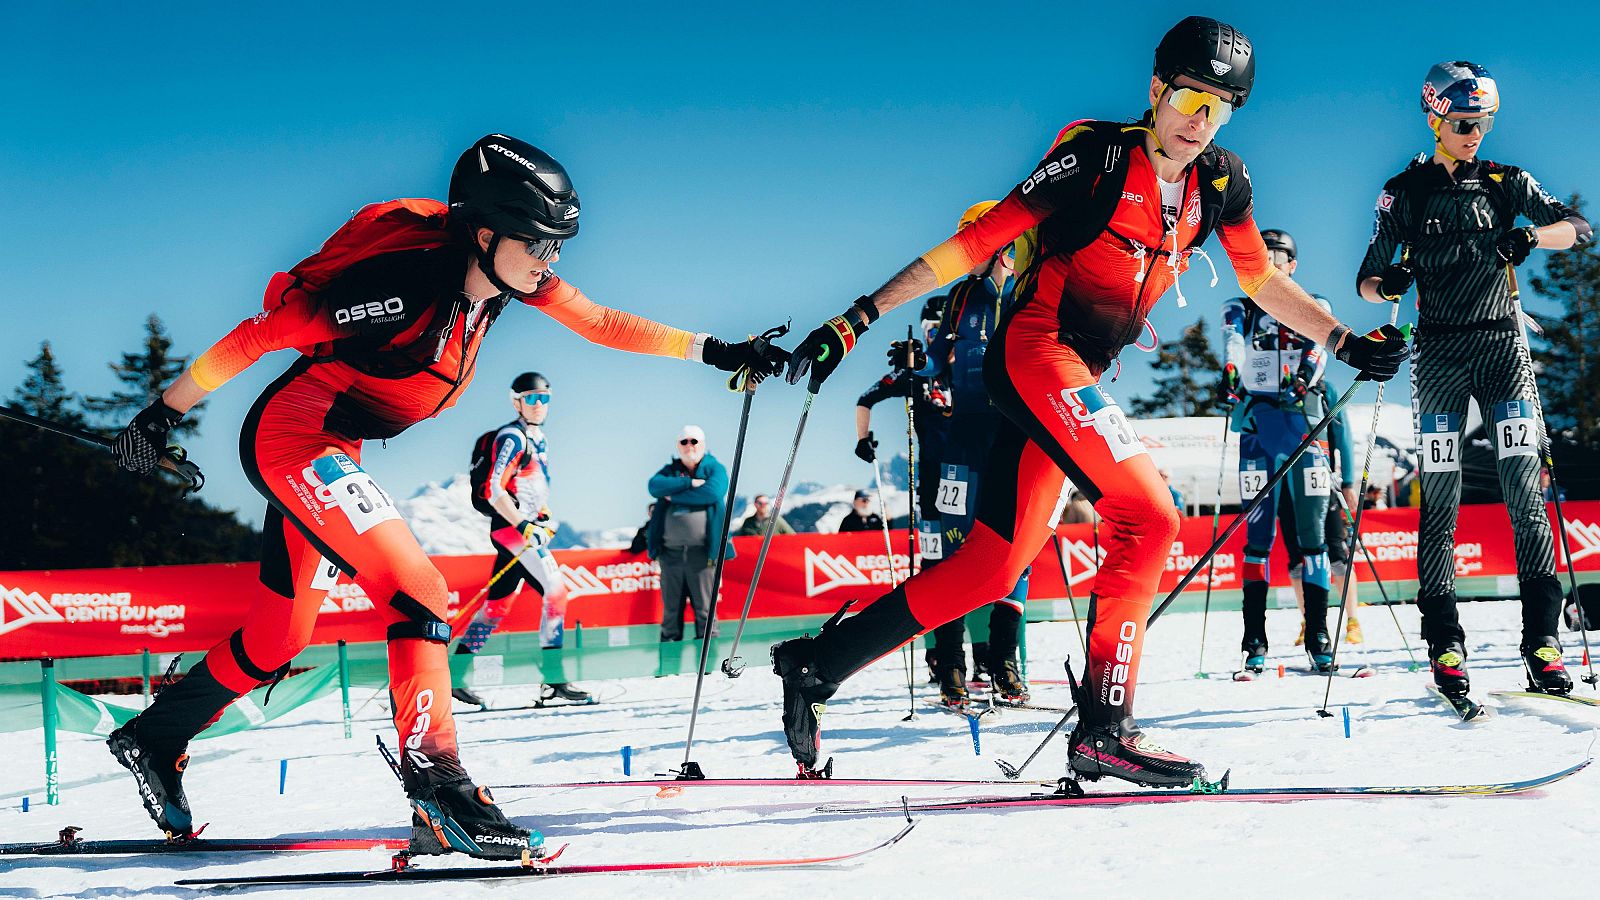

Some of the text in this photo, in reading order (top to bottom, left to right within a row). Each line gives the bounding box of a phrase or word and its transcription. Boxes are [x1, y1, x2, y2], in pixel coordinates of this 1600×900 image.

[488, 143, 537, 171] ATOMIC
[1504, 424, 1529, 449] 6.2
[1431, 438, 1455, 463] 6.2
[1244, 475, 1261, 492] 5.2
[1311, 471, 1327, 489] 5.2
[346, 479, 391, 514] 3.1
[942, 485, 959, 507] 2.2
[65, 605, 185, 621] DENTS DU MIDI
[1101, 660, 1112, 705] FAST&LIGHT
[1075, 743, 1144, 773] DYNAFIT
[475, 834, 528, 848] SCARPA
